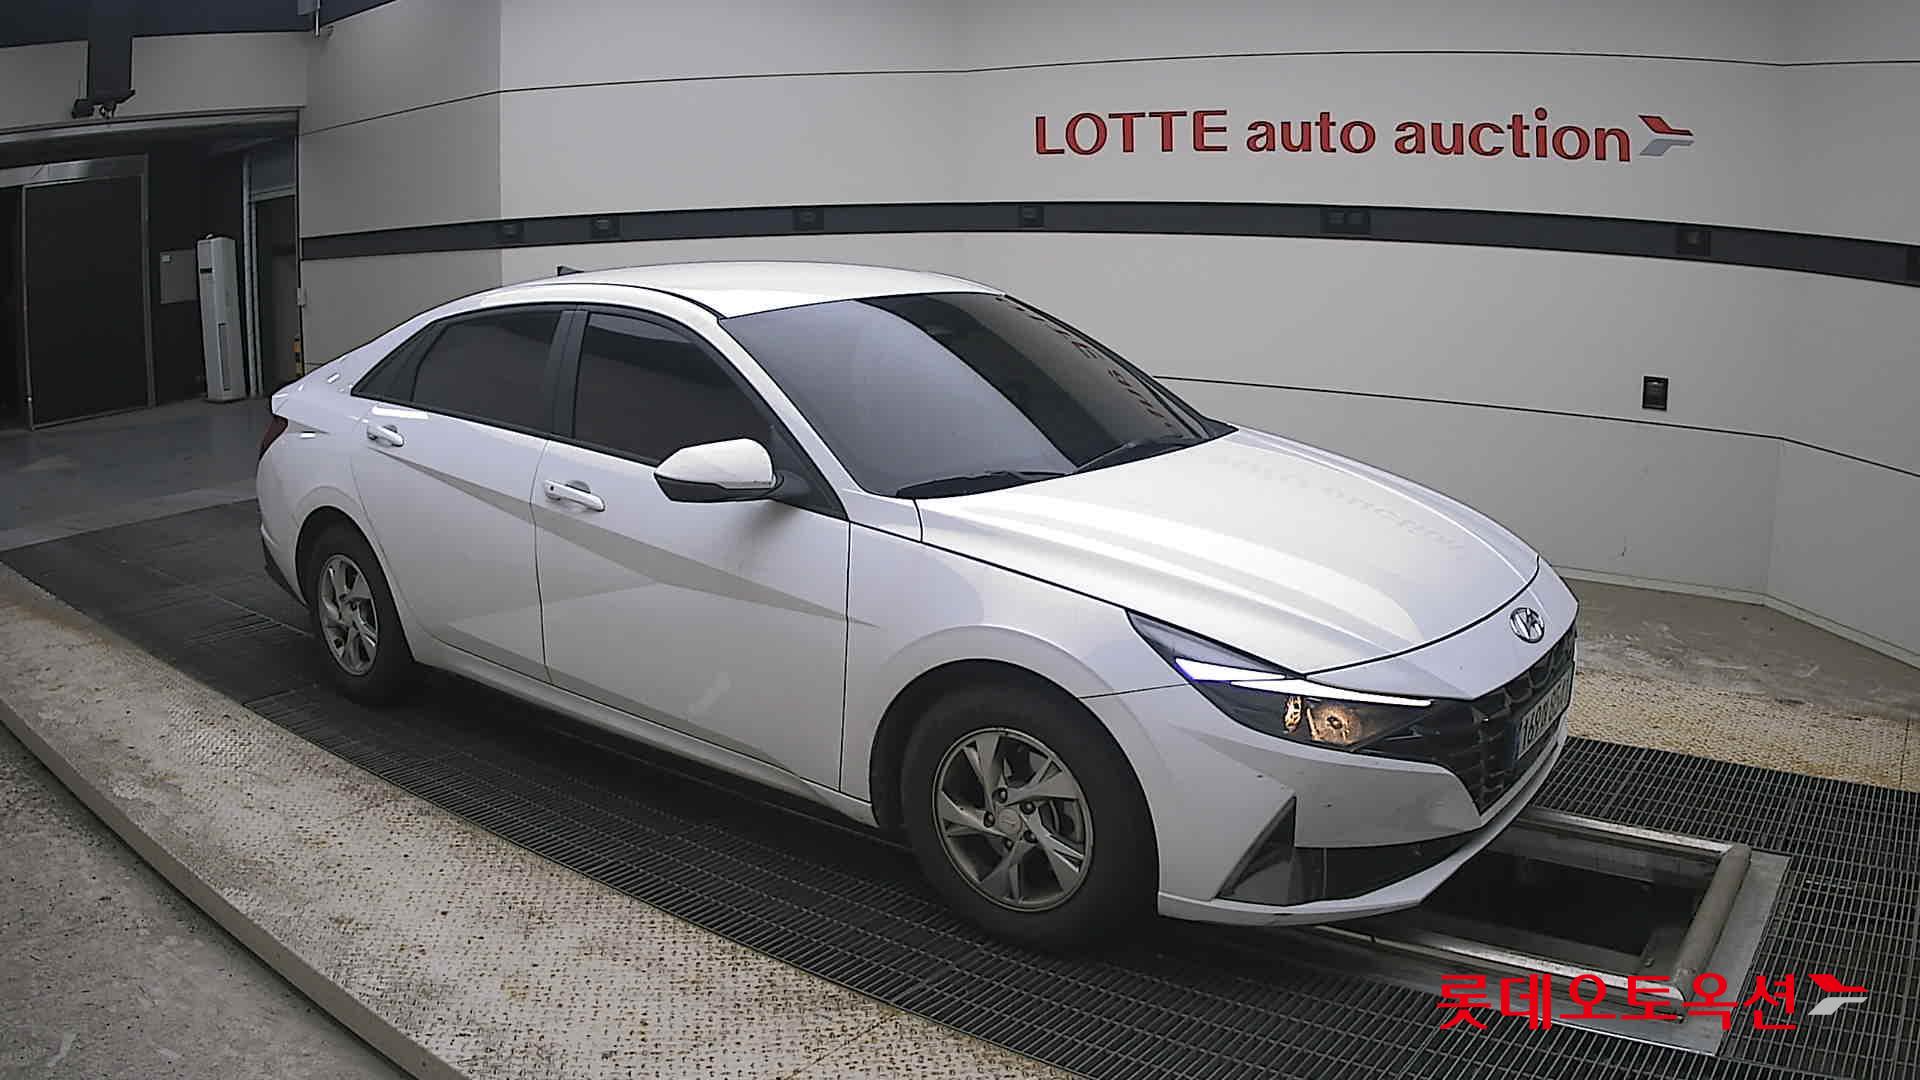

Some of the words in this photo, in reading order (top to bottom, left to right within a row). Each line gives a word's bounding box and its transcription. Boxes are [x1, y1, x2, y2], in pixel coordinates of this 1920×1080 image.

[1035, 109, 1229, 155] LOTTE
[1246, 111, 1376, 154] auto
[1394, 108, 1631, 162] auction
